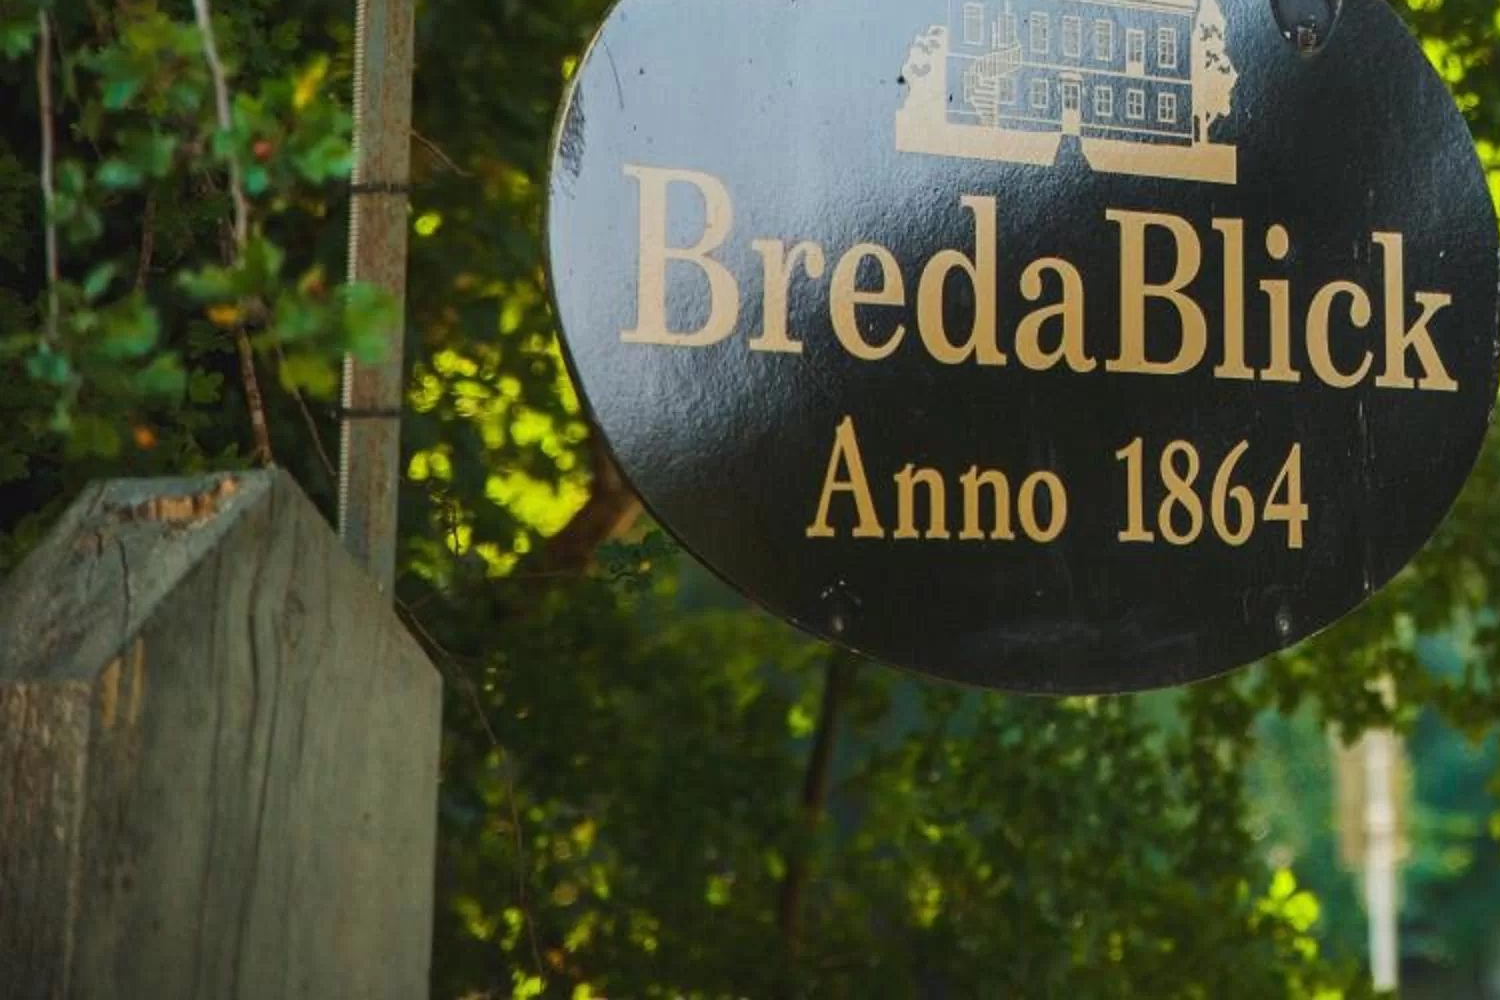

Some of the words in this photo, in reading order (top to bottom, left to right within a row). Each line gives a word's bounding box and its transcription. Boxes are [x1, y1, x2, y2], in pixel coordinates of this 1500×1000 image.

[620, 164, 1458, 391] BredaBlick
[806, 415, 1067, 542] Anno
[1116, 438, 1309, 549] 1864
